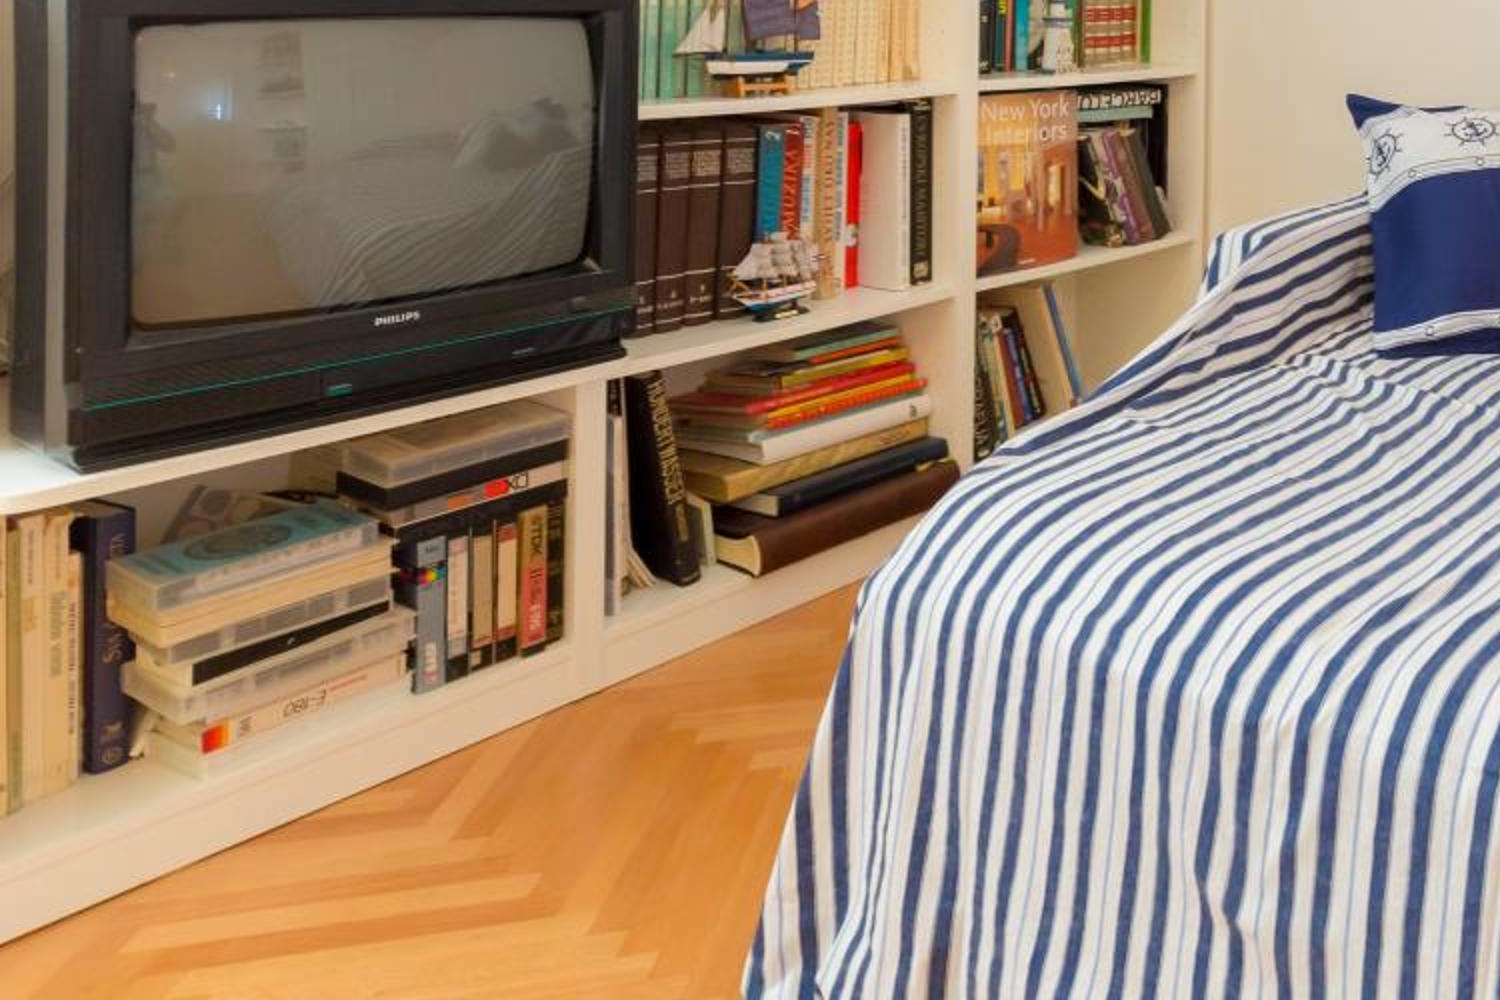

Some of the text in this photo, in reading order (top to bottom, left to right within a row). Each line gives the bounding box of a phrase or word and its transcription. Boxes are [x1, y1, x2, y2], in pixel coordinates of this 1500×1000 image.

[981, 102, 1025, 122] New
[1029, 95, 1070, 120] York
[986, 122, 1069, 144] Interiors
[373, 310, 421, 327] PHILIPS
